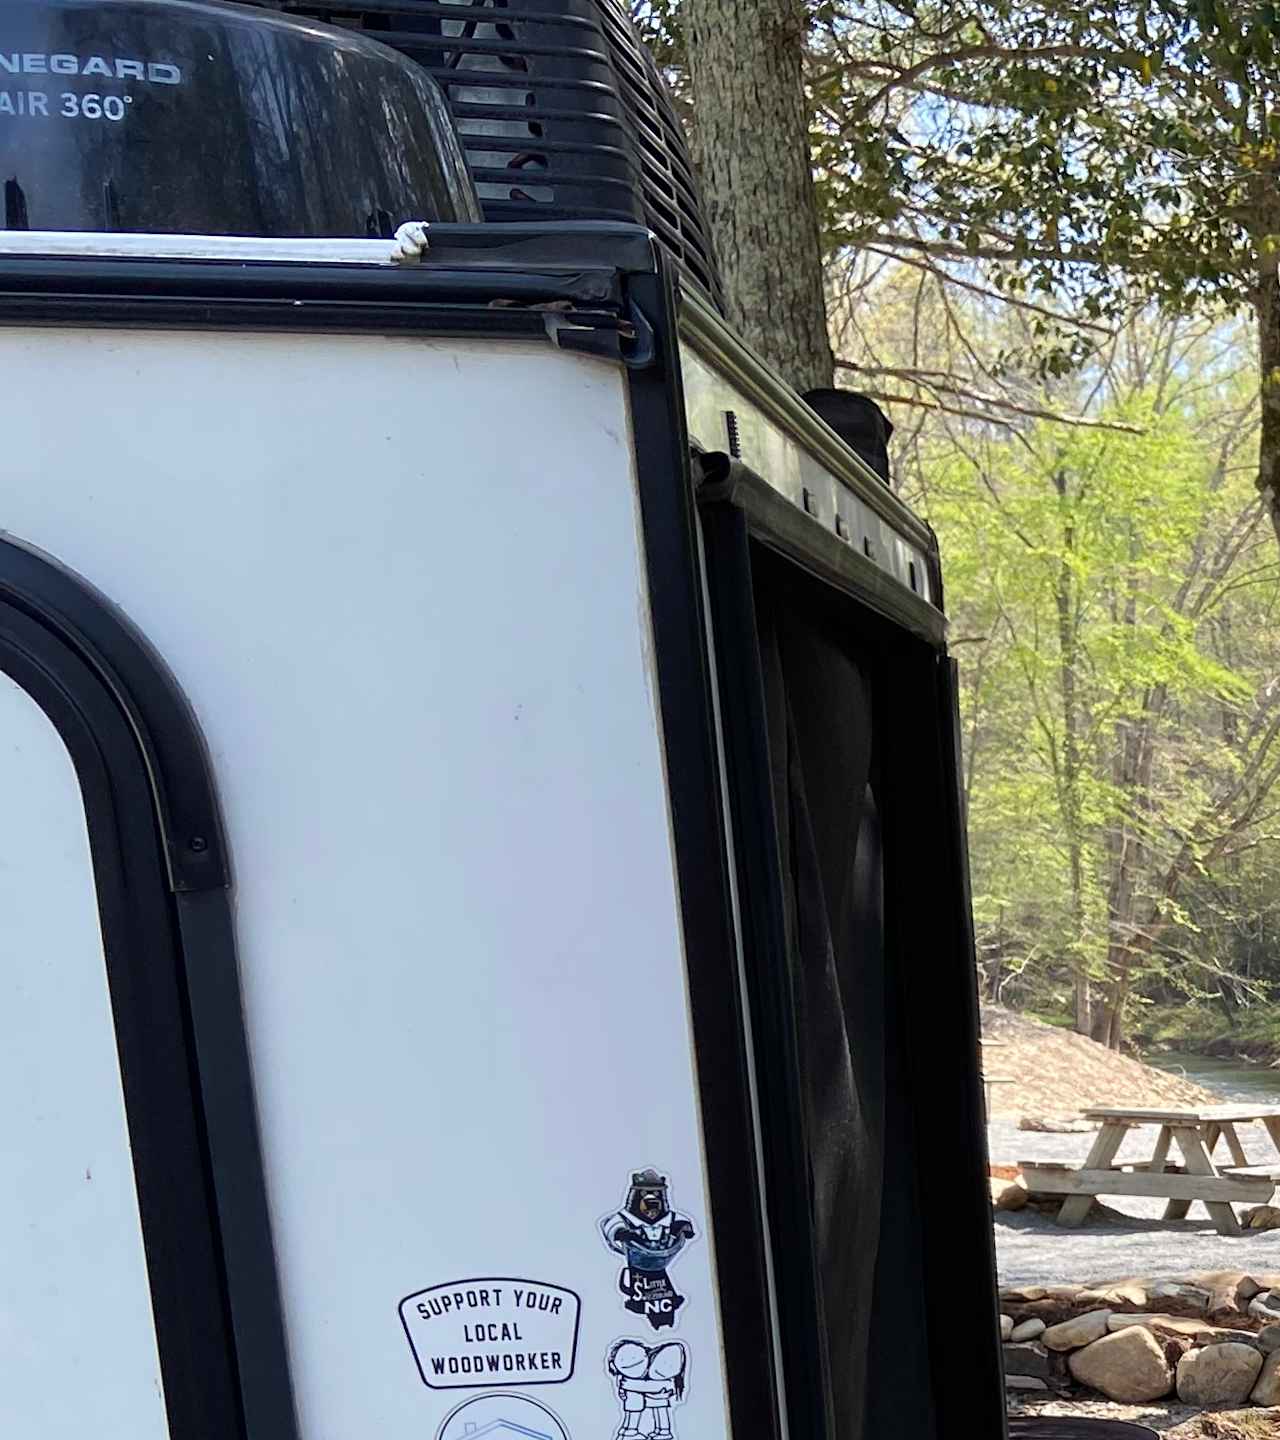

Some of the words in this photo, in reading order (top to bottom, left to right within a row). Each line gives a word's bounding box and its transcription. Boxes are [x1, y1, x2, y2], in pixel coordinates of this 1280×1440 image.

[416, 1289, 502, 1320] SUPPORT
[513, 1289, 563, 1315] YOUR
[644, 1299, 673, 1314] NC
[464, 1322, 523, 1343] LOCAL
[431, 1351, 562, 1375] WOODWORKER
